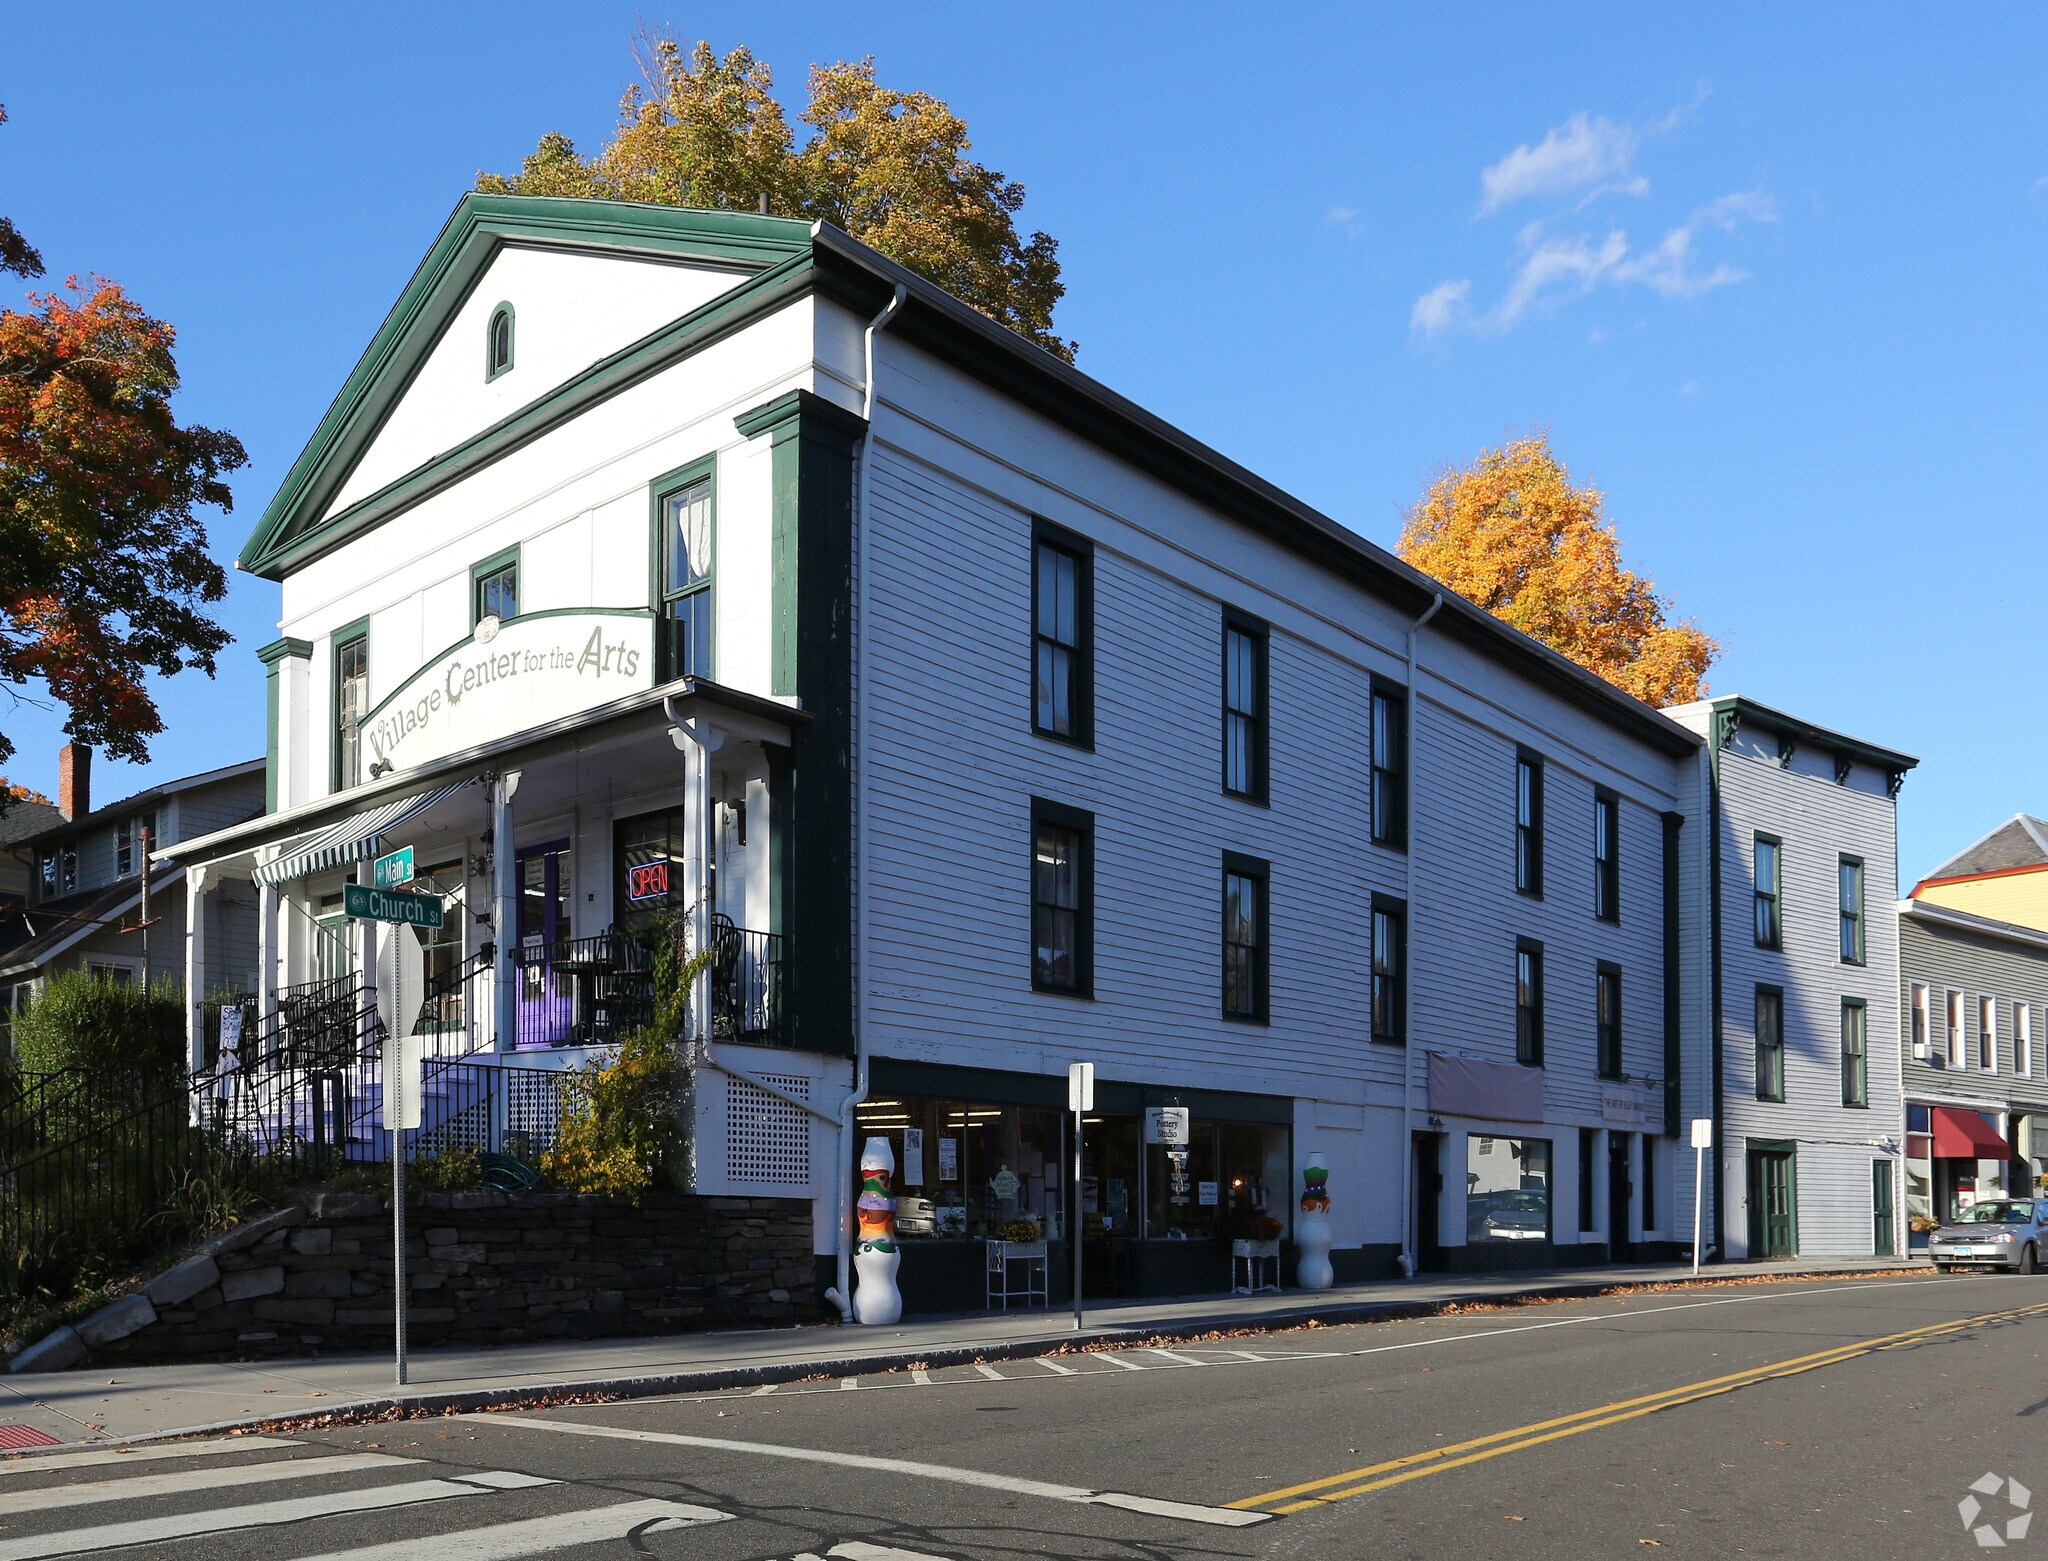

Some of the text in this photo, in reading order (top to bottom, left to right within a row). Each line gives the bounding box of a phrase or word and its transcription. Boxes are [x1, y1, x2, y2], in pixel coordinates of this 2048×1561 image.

[370, 688, 441, 762] Village
[445, 649, 521, 706] Center
[524, 649, 546, 673] for
[550, 646, 574, 669] the
[577, 625, 640, 678] Arts
[385, 856, 413, 883] Main St
[632, 865, 668, 897] OPEN
[369, 891, 439, 923] Church St
[1156, 1120, 1178, 1129] Pottery
[1157, 1129, 1178, 1138] Studio
